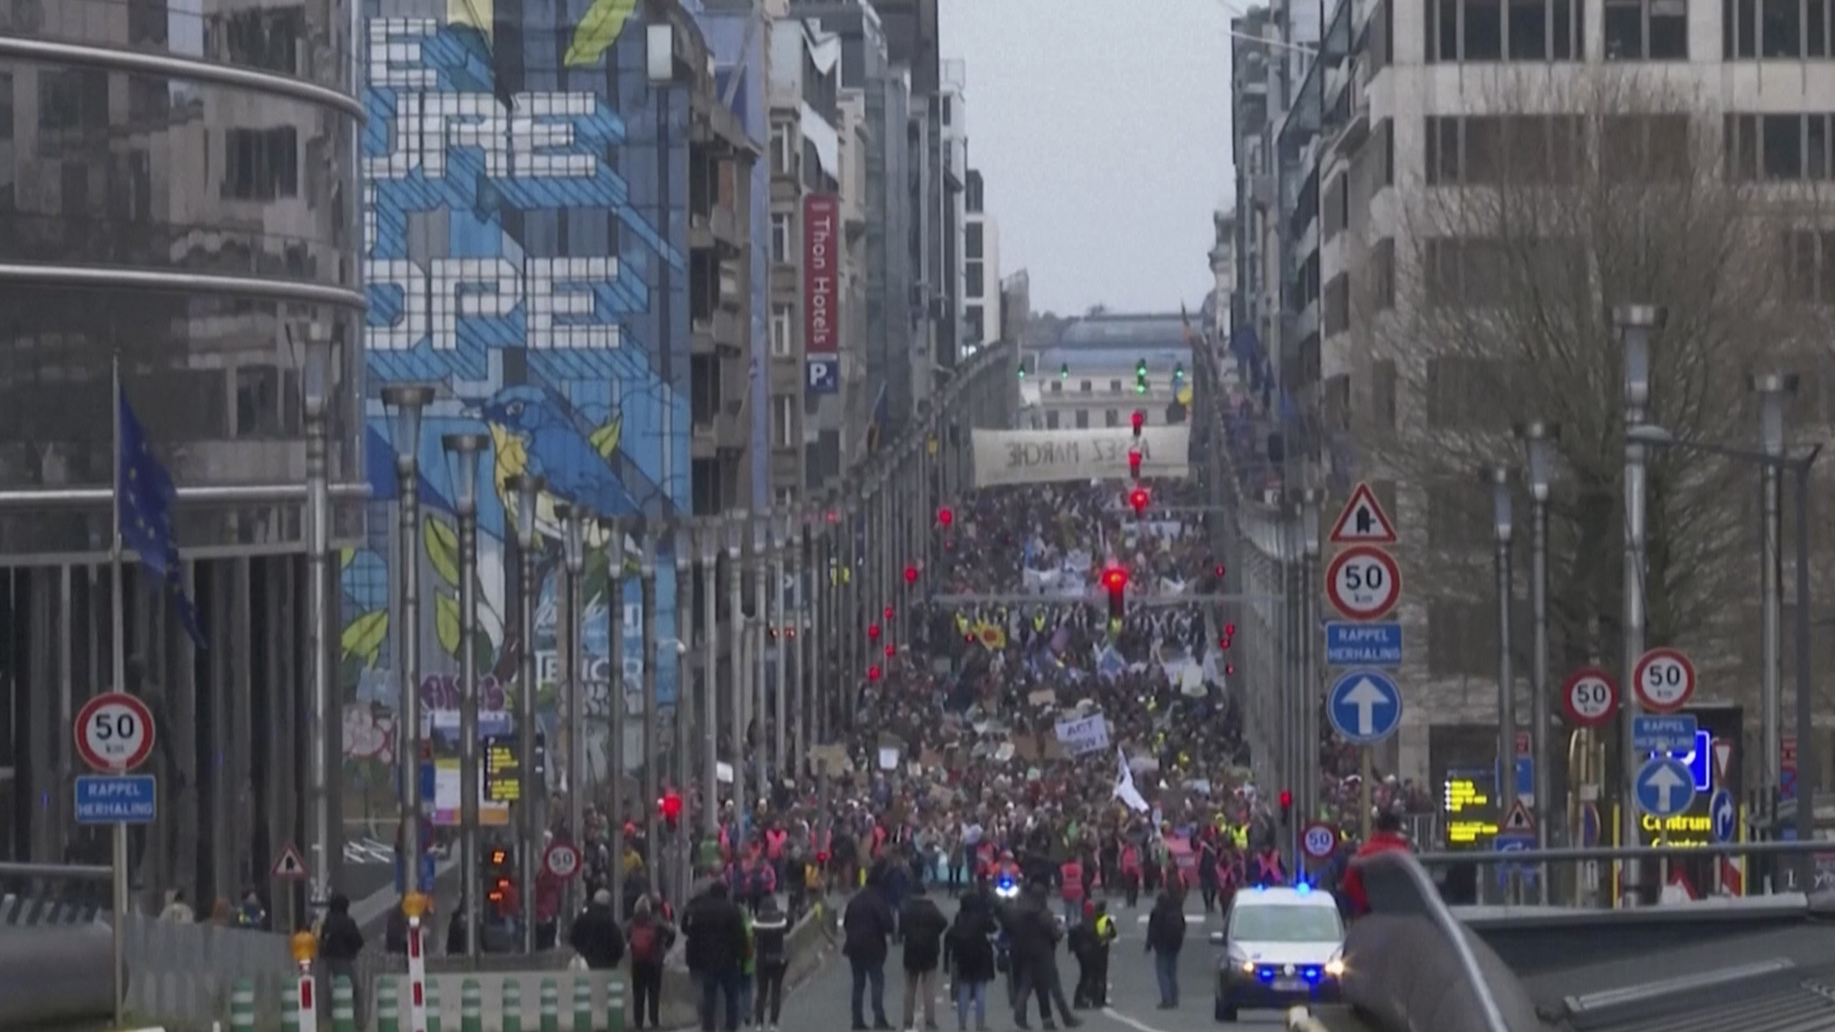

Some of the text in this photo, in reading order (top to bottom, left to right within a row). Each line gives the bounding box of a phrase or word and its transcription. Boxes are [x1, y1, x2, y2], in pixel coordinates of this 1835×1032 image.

[812, 214, 831, 343] Thon Hotels
[1345, 564, 1382, 590] 50
[1338, 628, 1389, 642] RAPPEL
[1328, 647, 1400, 660] HERHALING
[1649, 664, 1681, 686] 50
[1577, 683, 1606, 704] 50
[95, 714, 135, 739] 50
[1642, 721, 1685, 732] RAPPEL
[87, 782, 141, 796] RAPPEL
[78, 802, 153, 816] HERHALING
[1309, 832, 1330, 846] 50
[552, 852, 573, 867] 50
